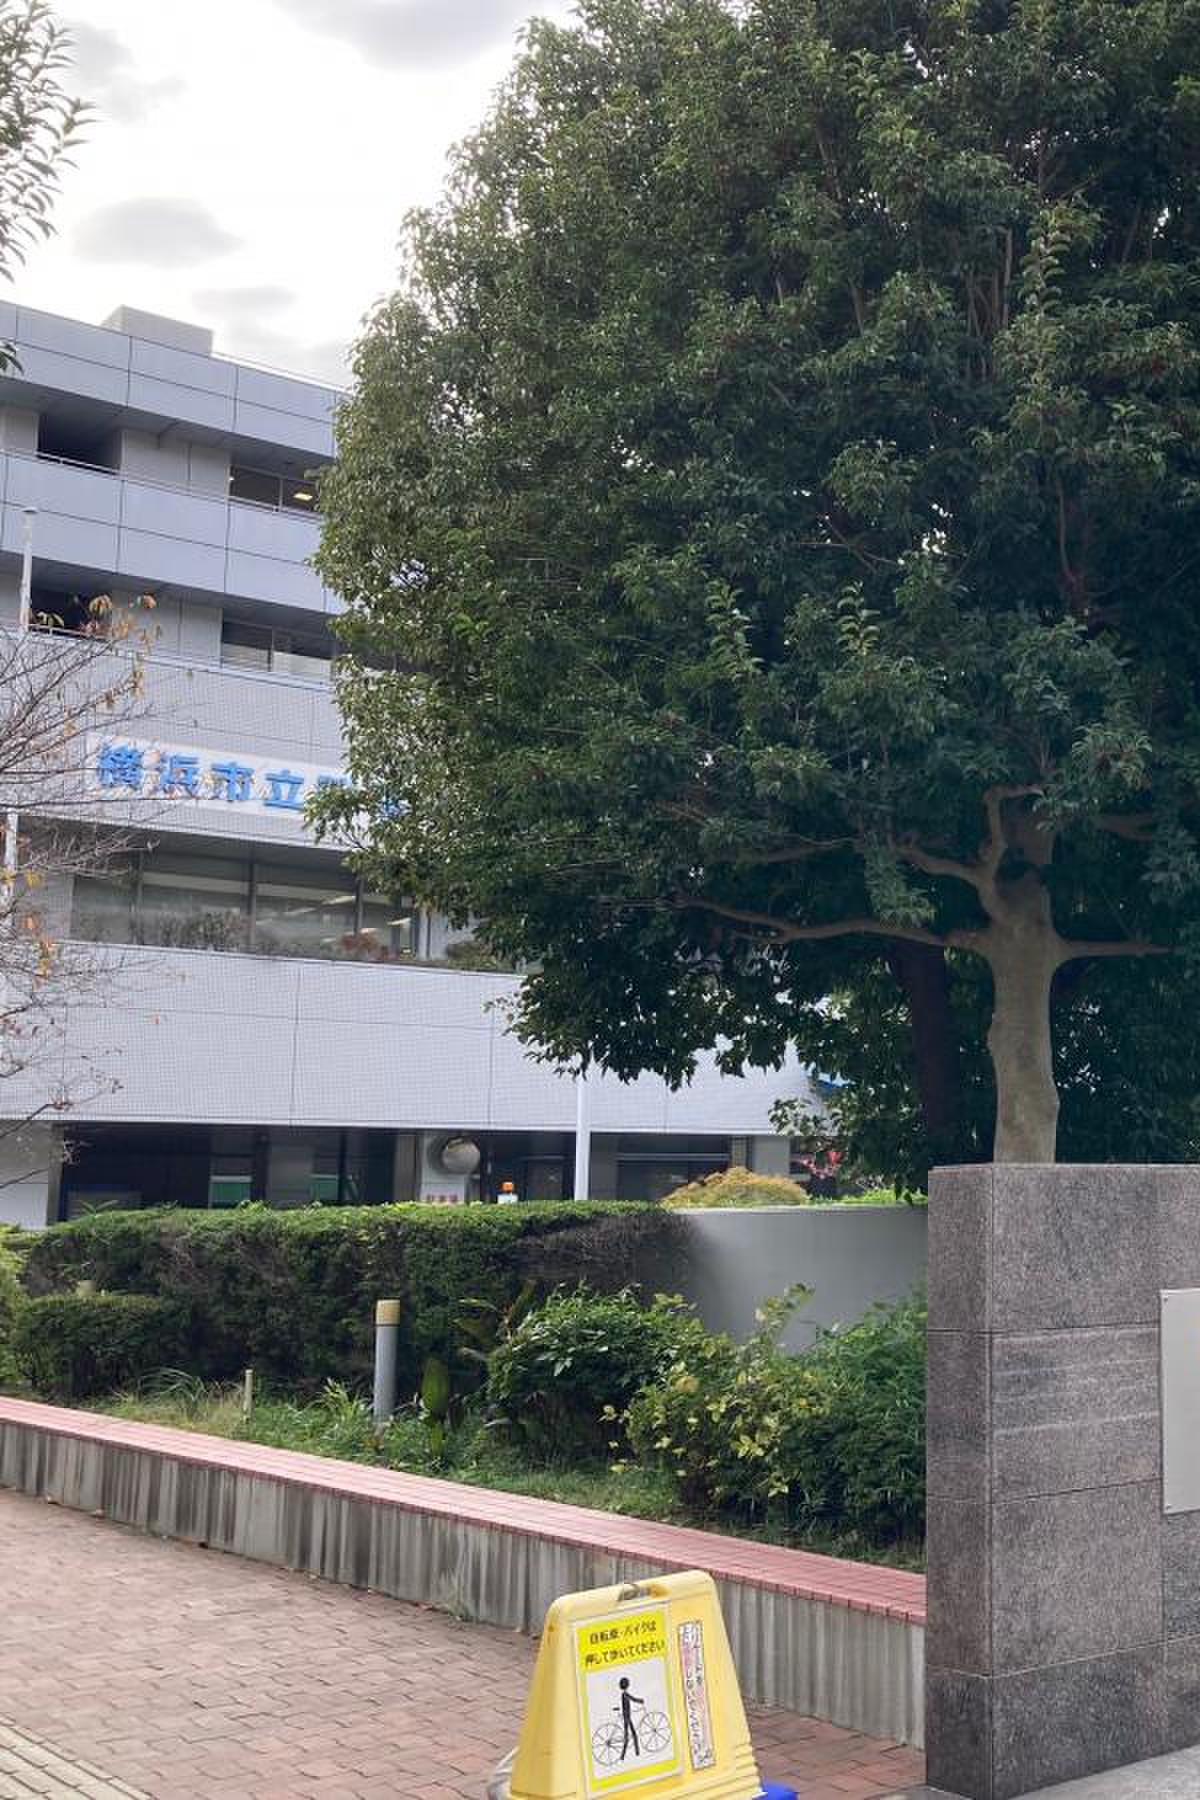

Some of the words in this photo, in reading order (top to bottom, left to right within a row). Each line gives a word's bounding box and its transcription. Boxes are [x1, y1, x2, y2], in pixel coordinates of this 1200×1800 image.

[585, 1641, 665, 1668] 押して歩いてください
